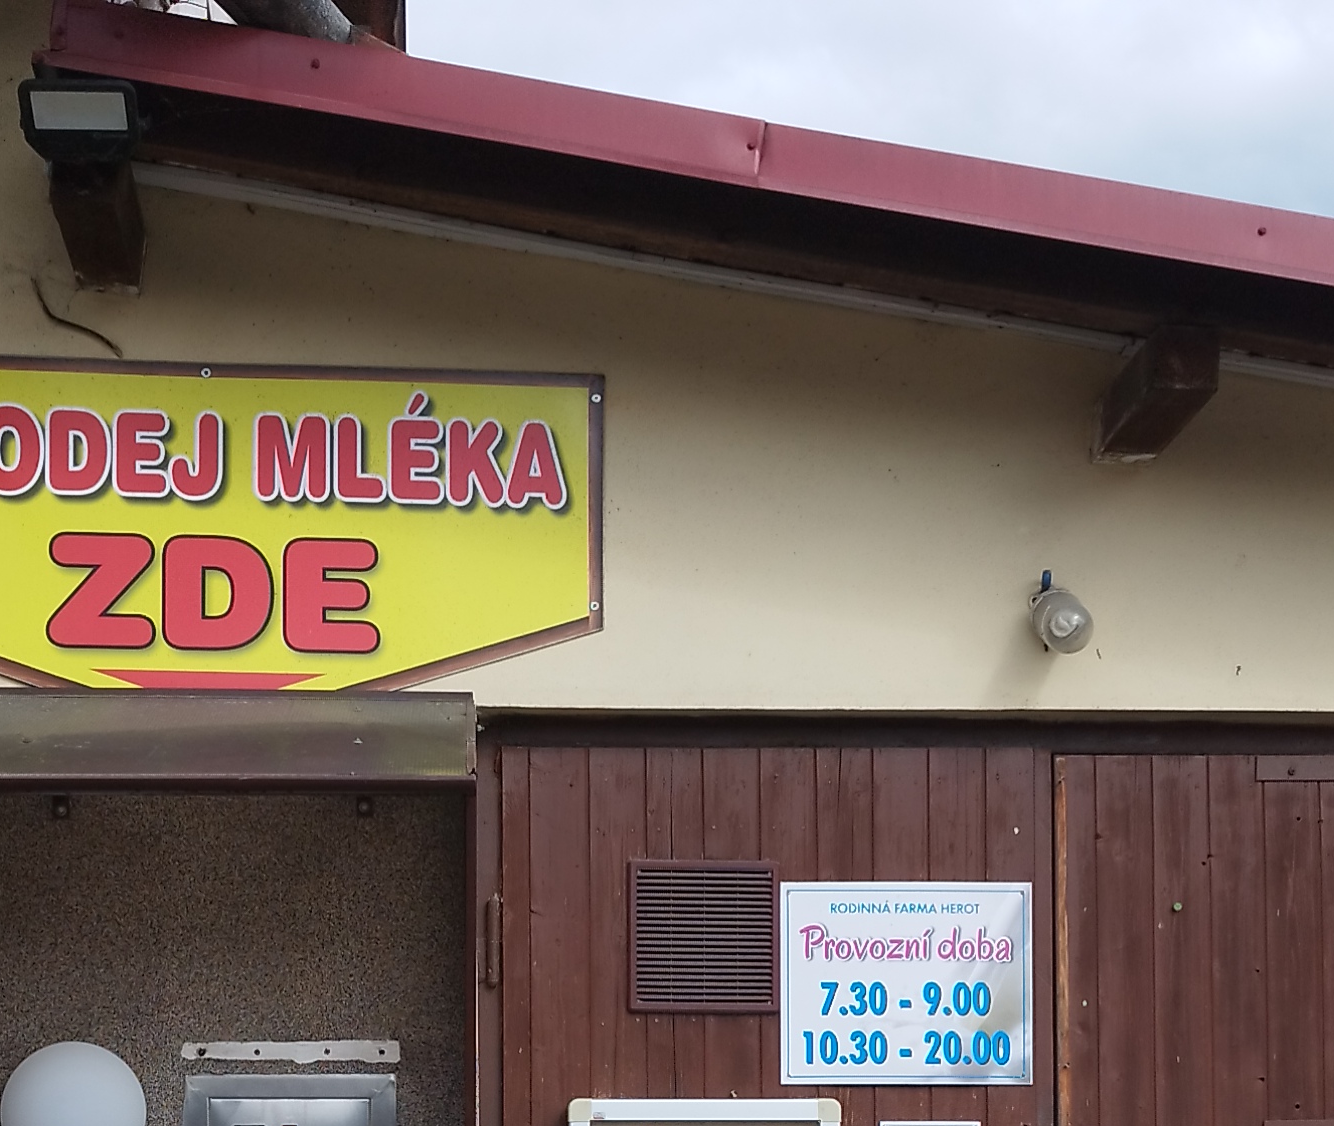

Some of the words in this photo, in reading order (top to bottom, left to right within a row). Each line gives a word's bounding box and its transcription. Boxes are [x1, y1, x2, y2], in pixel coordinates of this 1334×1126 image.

[255, 392, 569, 512] MLÉKA
[46, 531, 381, 654] ZDE
[830, 900, 891, 915] RODINNÁ
[894, 903, 936, 915] FARMA
[940, 903, 980, 915] HEROT
[798, 924, 933, 961] Provozní
[936, 926, 1013, 963] doba
[820, 981, 887, 1016] 7.30
[923, 981, 991, 1016] 9.00
[802, 1030, 887, 1066] 10.30
[924, 1030, 1011, 1066] 20.00
